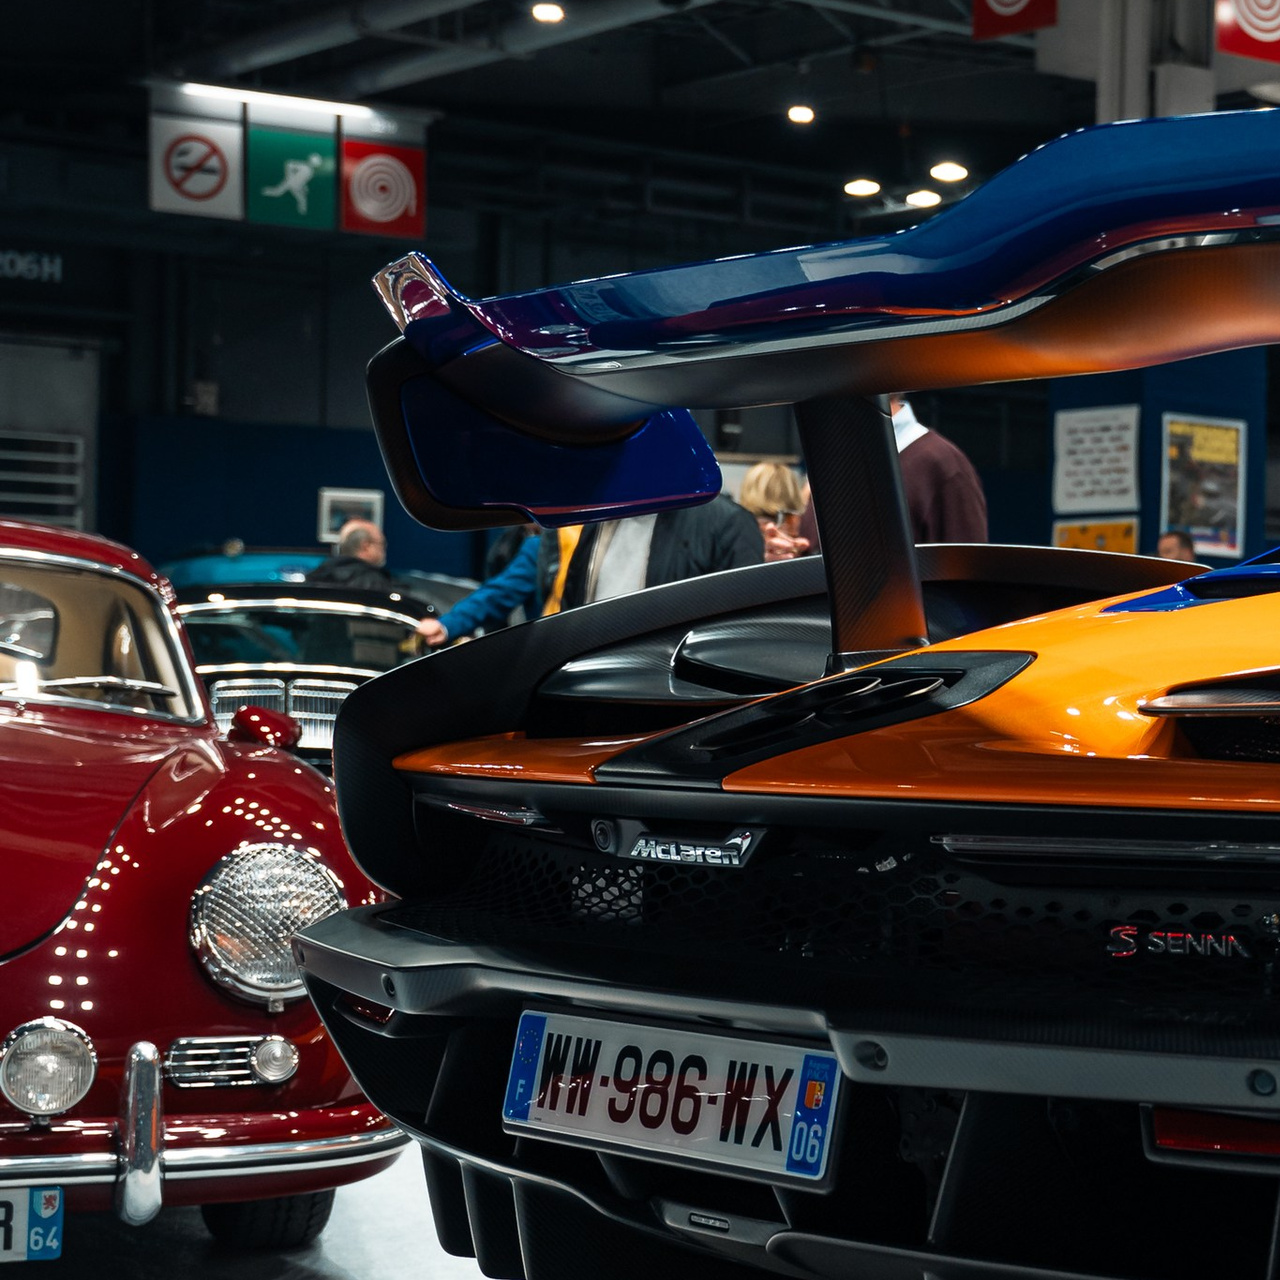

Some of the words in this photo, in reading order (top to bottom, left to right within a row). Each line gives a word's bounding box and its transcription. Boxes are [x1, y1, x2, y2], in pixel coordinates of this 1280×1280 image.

[630, 838, 740, 865] McLaren
[1147, 931, 1251, 958] SENNA
[514, 1079, 527, 1101] F
[536, 1031, 795, 1152] WW-986-WX
[791, 1121, 823, 1164] 06
[30, 1226, 60, 1251] 64
